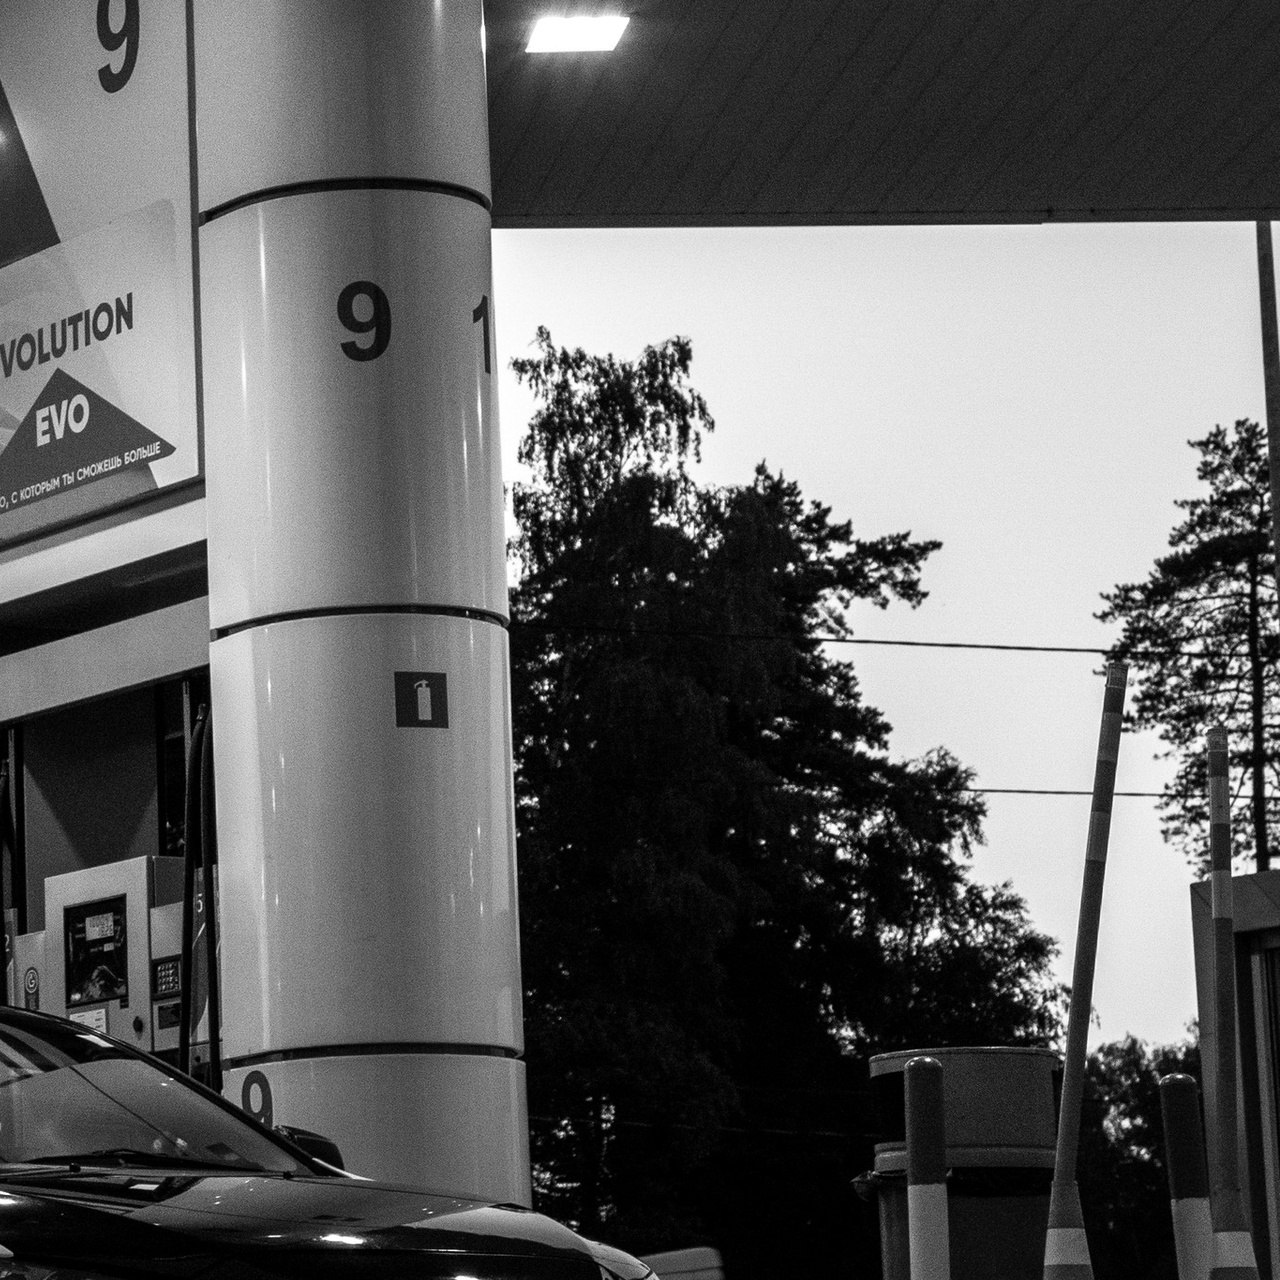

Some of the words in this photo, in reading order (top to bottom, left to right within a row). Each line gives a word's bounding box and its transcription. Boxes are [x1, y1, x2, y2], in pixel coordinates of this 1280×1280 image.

[337, 280, 392, 362] 9
[35, 393, 90, 448] EVO
[11, 491, 18, 504] С
[20, 478, 61, 501] КОТОРЫМ
[61, 473, 75, 487] ТЫ
[76, 456, 122, 481] СМОЖЕШЬ
[124, 441, 162, 465] БОЛЬШЕ
